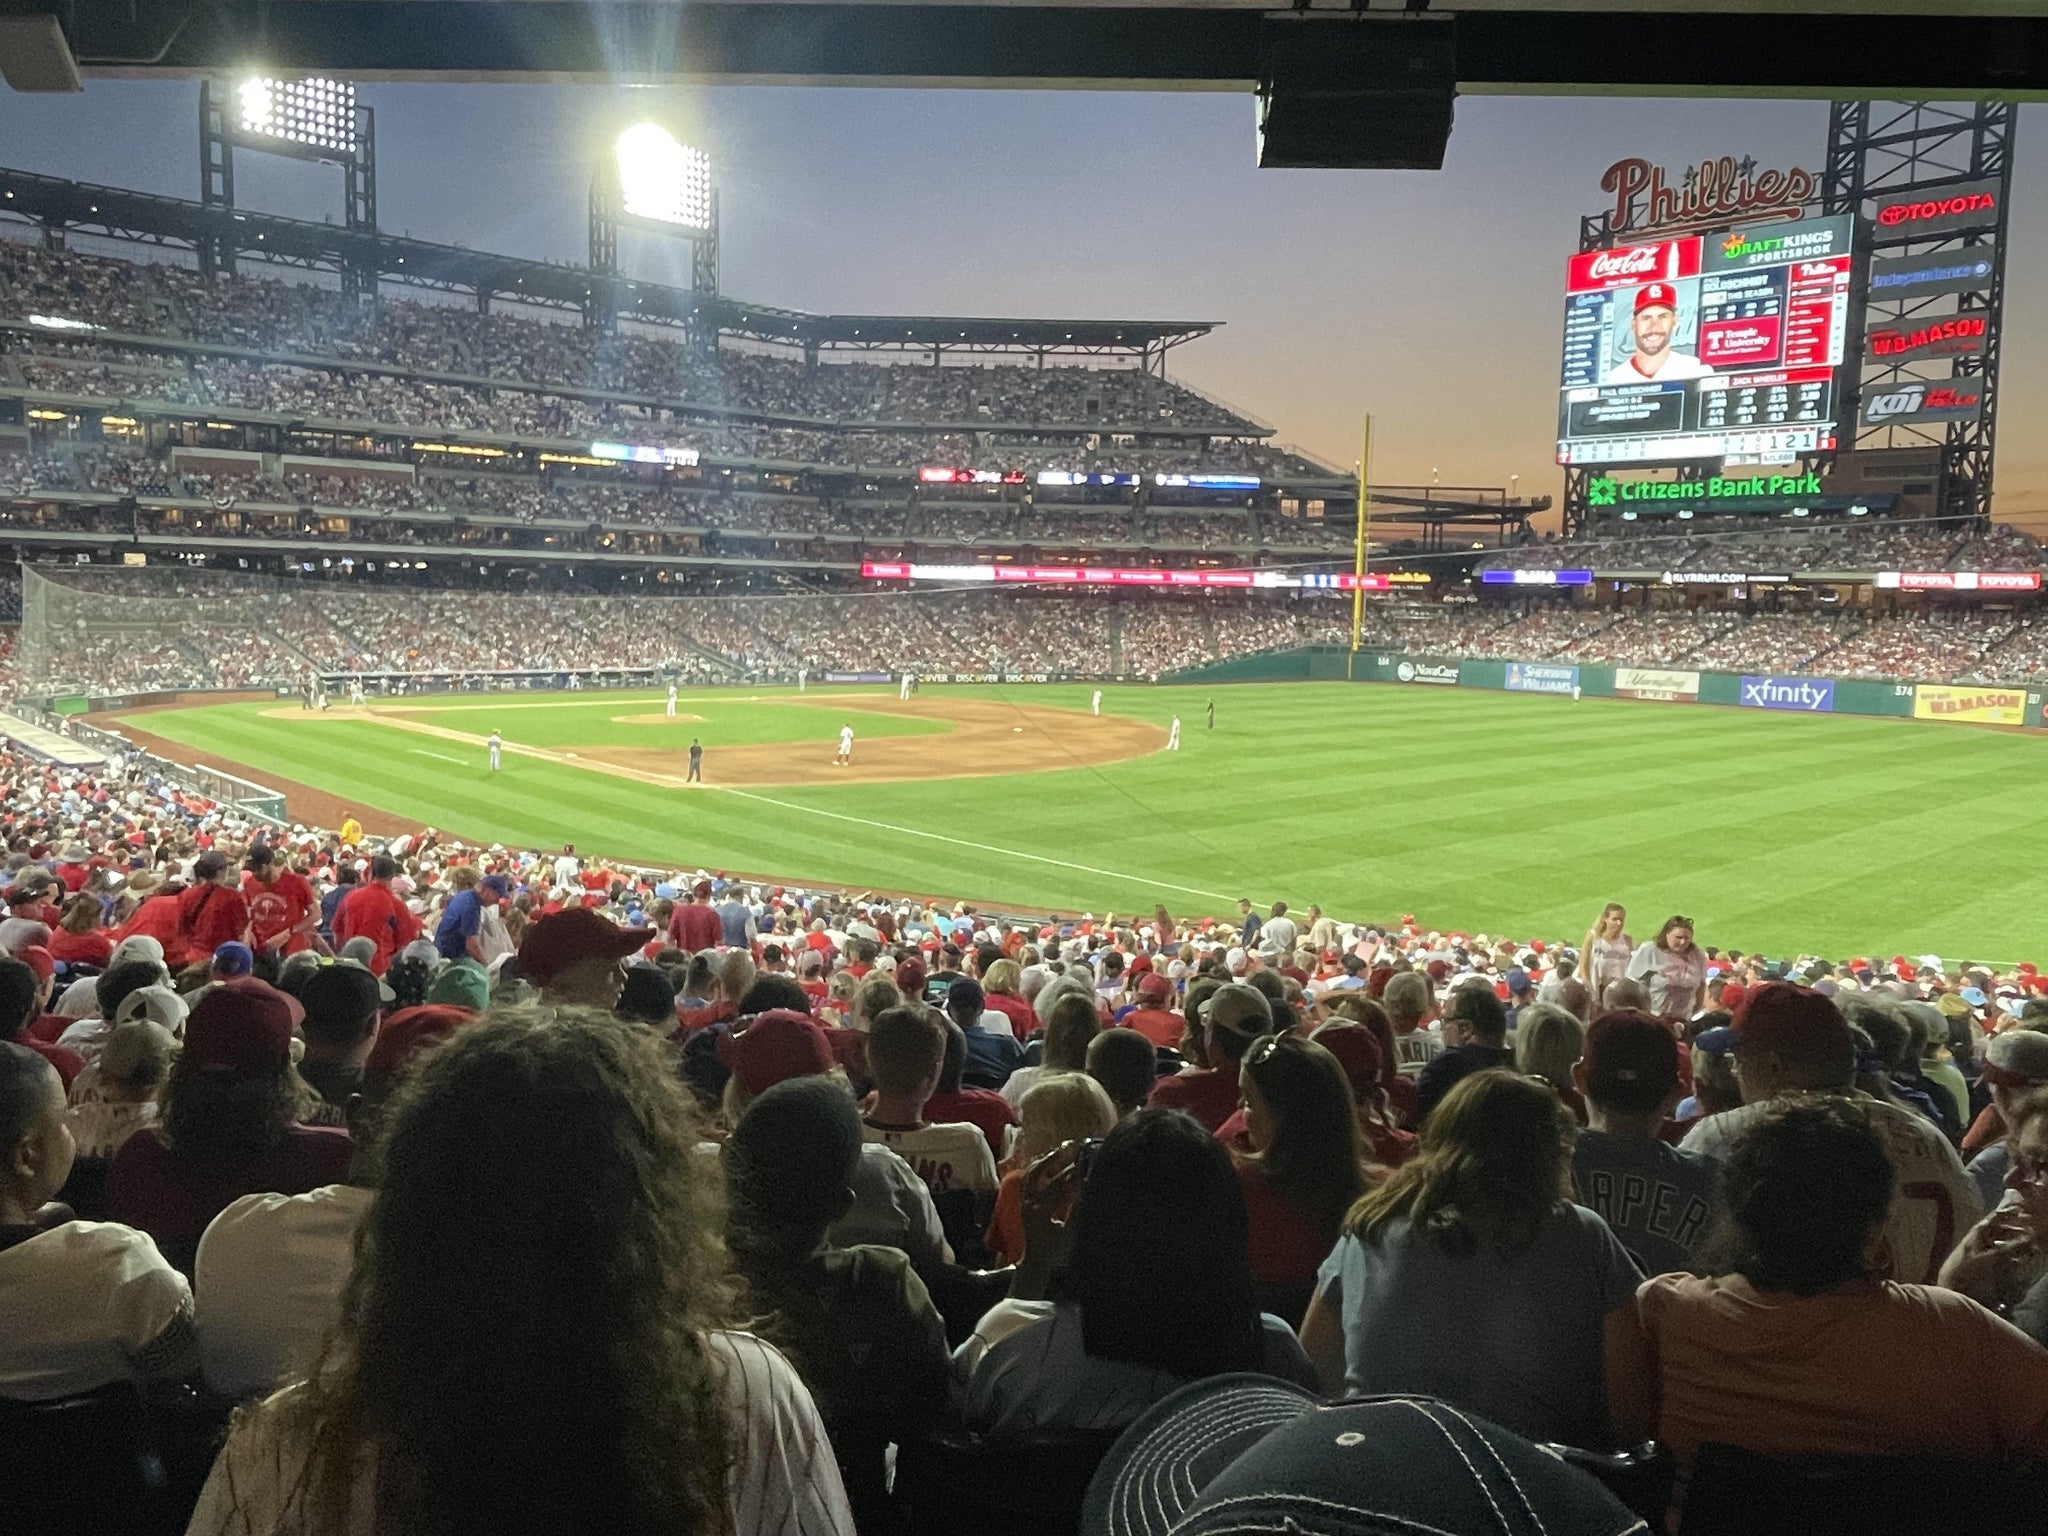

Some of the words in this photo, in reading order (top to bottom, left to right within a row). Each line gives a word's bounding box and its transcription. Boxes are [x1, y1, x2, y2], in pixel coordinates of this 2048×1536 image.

[1601, 157, 1814, 231] Phillies
[1907, 193, 1995, 220] TOYOTA
[1749, 243, 1831, 264] SPORTSBOOK
[1770, 436, 1778, 449] 1
[1786, 435, 1796, 448] 2
[1803, 433, 1811, 447] 1
[1621, 480, 1704, 500] Citizens
[1709, 476, 1765, 497] Bank
[1769, 472, 1821, 494] Park
[1902, 575, 1953, 585] TOYOTA
[1981, 576, 2034, 586] TOYOTA
[955, 673, 998, 683] DISCOVER
[1005, 673, 1048, 683] DISCOVER
[1415, 663, 1459, 678] NovaCare
[1745, 679, 1828, 710] xfinity
